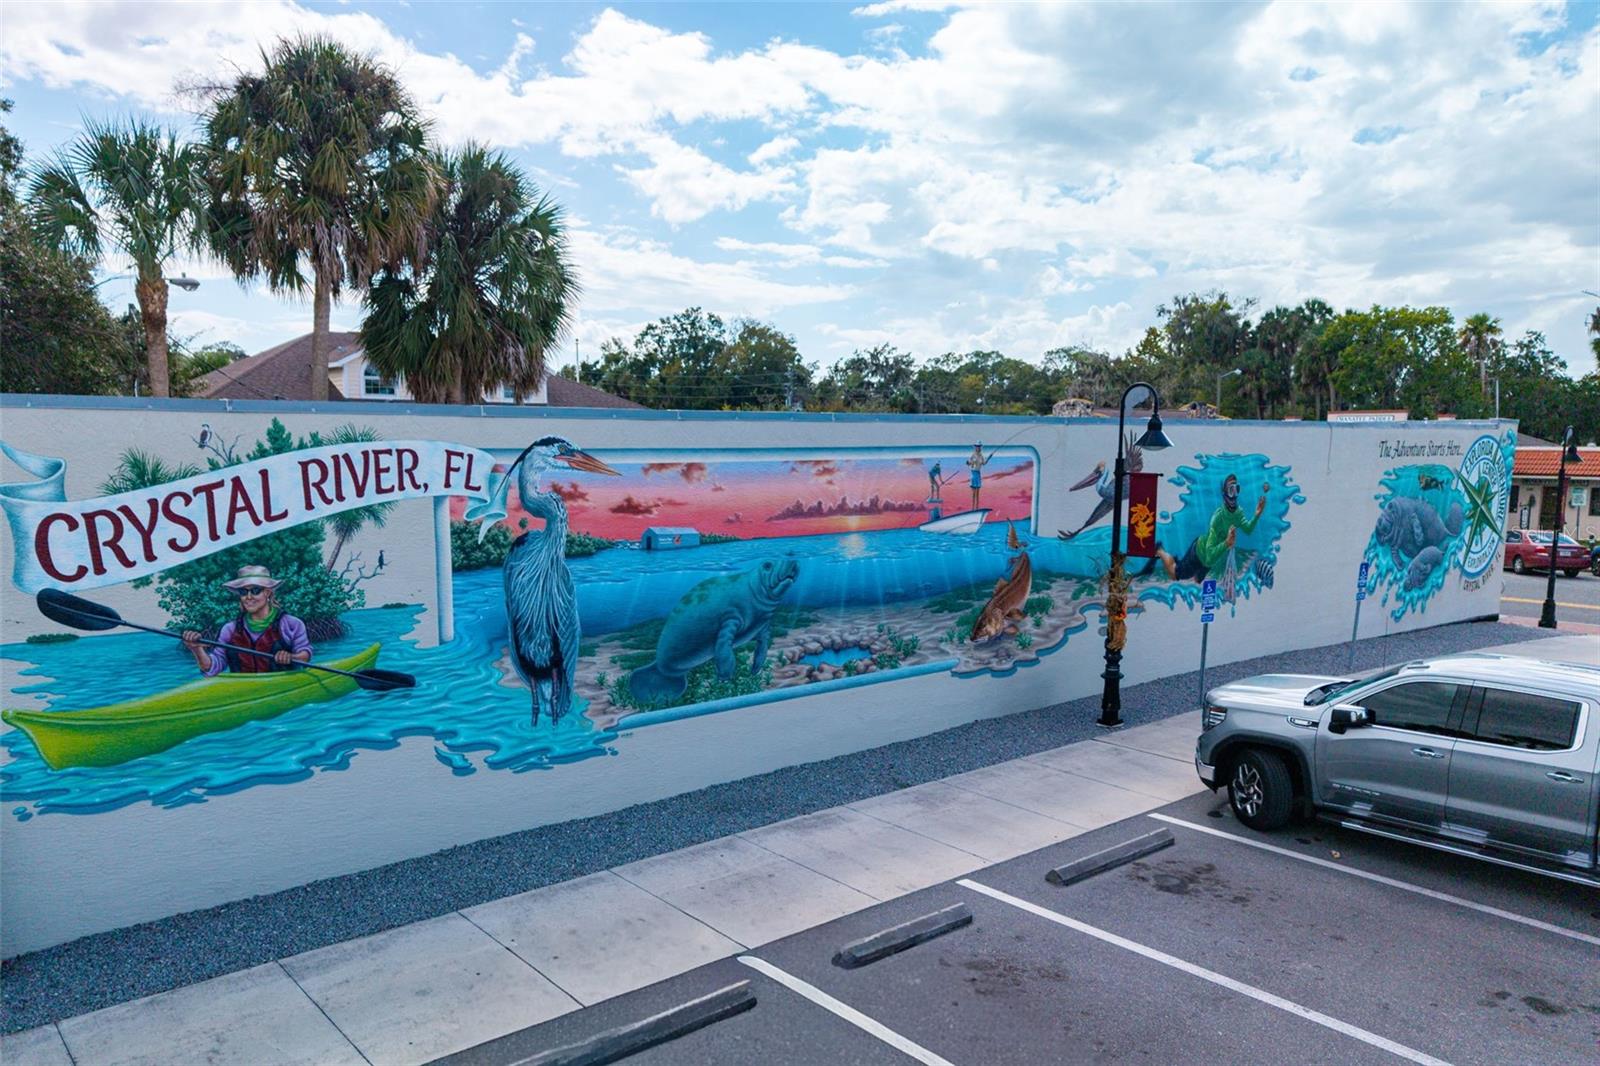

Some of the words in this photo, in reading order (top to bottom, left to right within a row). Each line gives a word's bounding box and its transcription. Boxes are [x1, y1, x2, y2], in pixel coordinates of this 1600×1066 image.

[1379, 440, 1391, 458] The
[1391, 440, 1426, 459] Adventure
[1427, 440, 1445, 457] Starts
[1464, 440, 1494, 474] EXPLORIDA
[1495, 455, 1507, 520] ADVENTURE
[34, 468, 289, 583] CRYSTAL
[297, 447, 429, 512] RIVER,
[442, 449, 483, 492] FL
[1463, 579, 1481, 593] CRYSTAL
